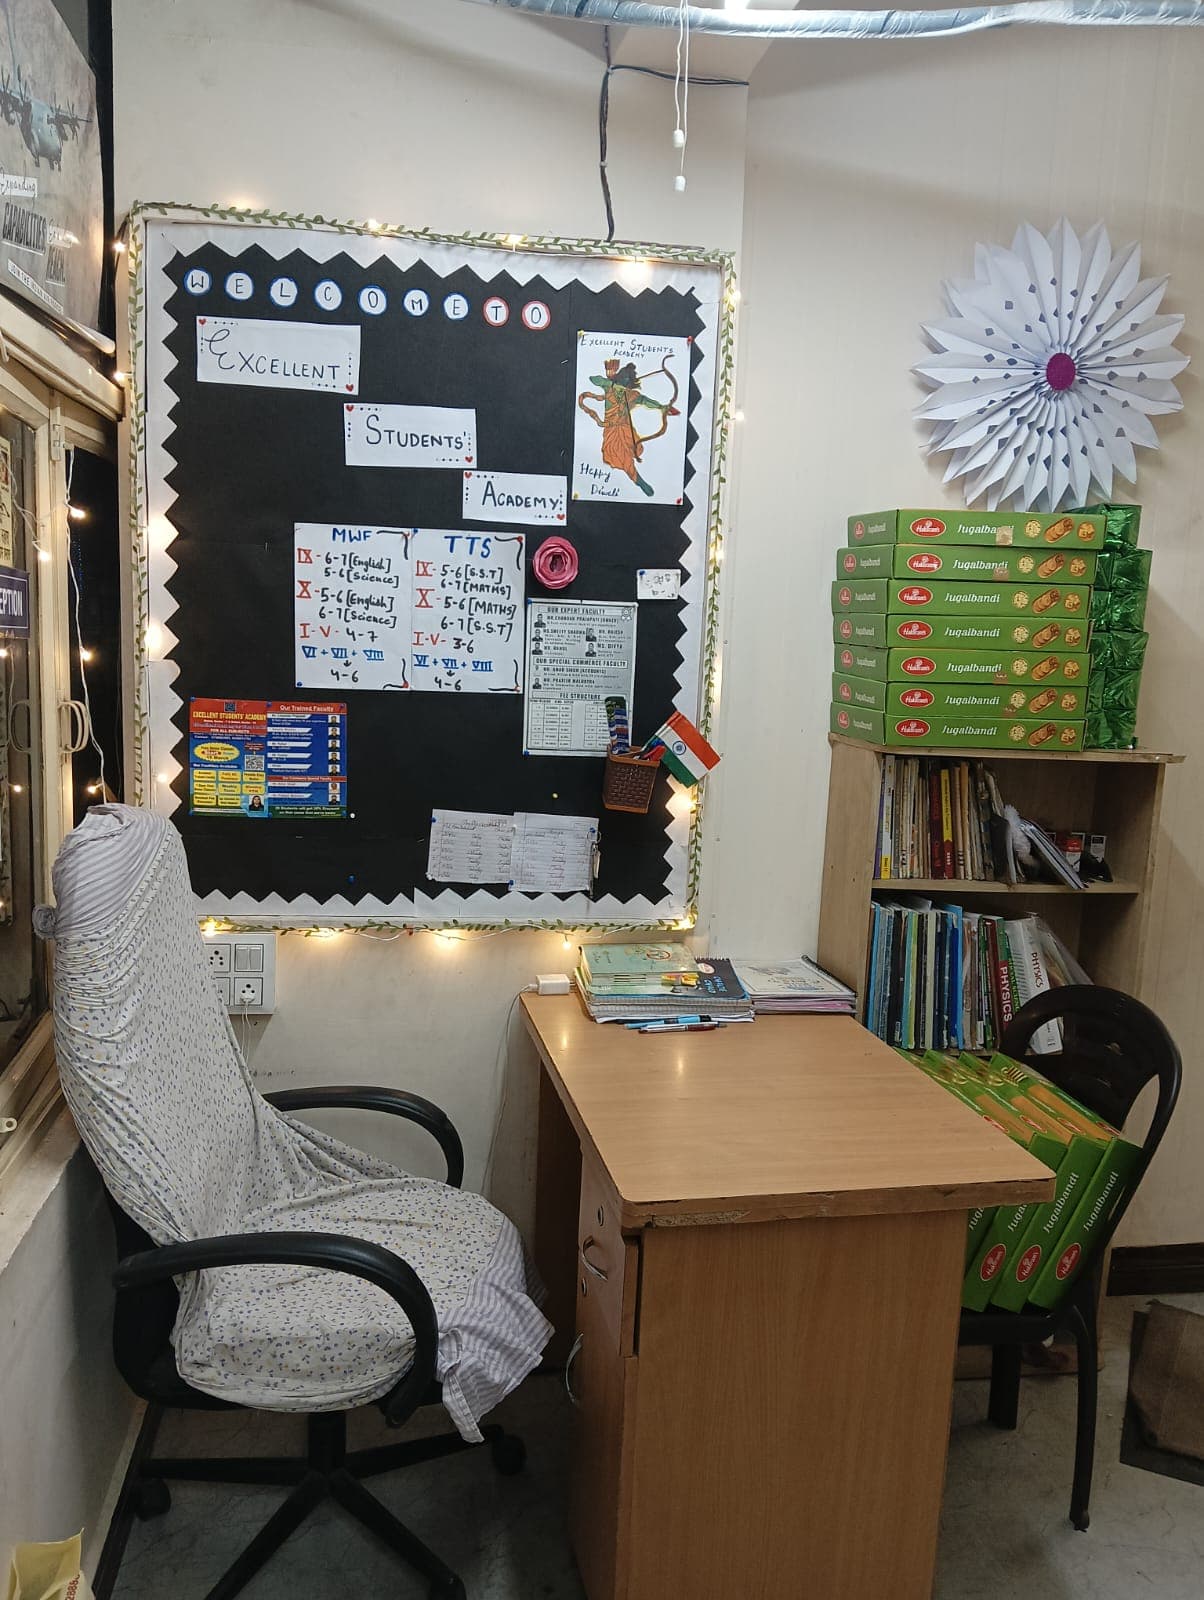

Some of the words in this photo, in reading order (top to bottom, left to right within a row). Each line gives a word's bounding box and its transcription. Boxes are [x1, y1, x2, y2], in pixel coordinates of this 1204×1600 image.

[204, 328, 341, 380] EXCELLENT
[482, 481, 560, 511] ACADEMY
[332, 528, 372, 542] MWF
[957, 524, 1014, 535] Jugalba
[444, 536, 492, 558] TTS
[953, 559, 1008, 570] Jugalbandi
[944, 593, 1001, 604] Jugalbandi
[944, 627, 1001, 637] Jugalbandi
[946, 663, 1002, 673] Jugalbandi
[945, 695, 1000, 706] Jugalbandi
[942, 725, 998, 735] Jugalbandi
[1031, 952, 1044, 988] PHYSICS
[1000, 966, 1013, 1022] PHYSICS
[1043, 1172, 1079, 1233] Jugalbandi
[1083, 1171, 1119, 1232] Jugalbandi
